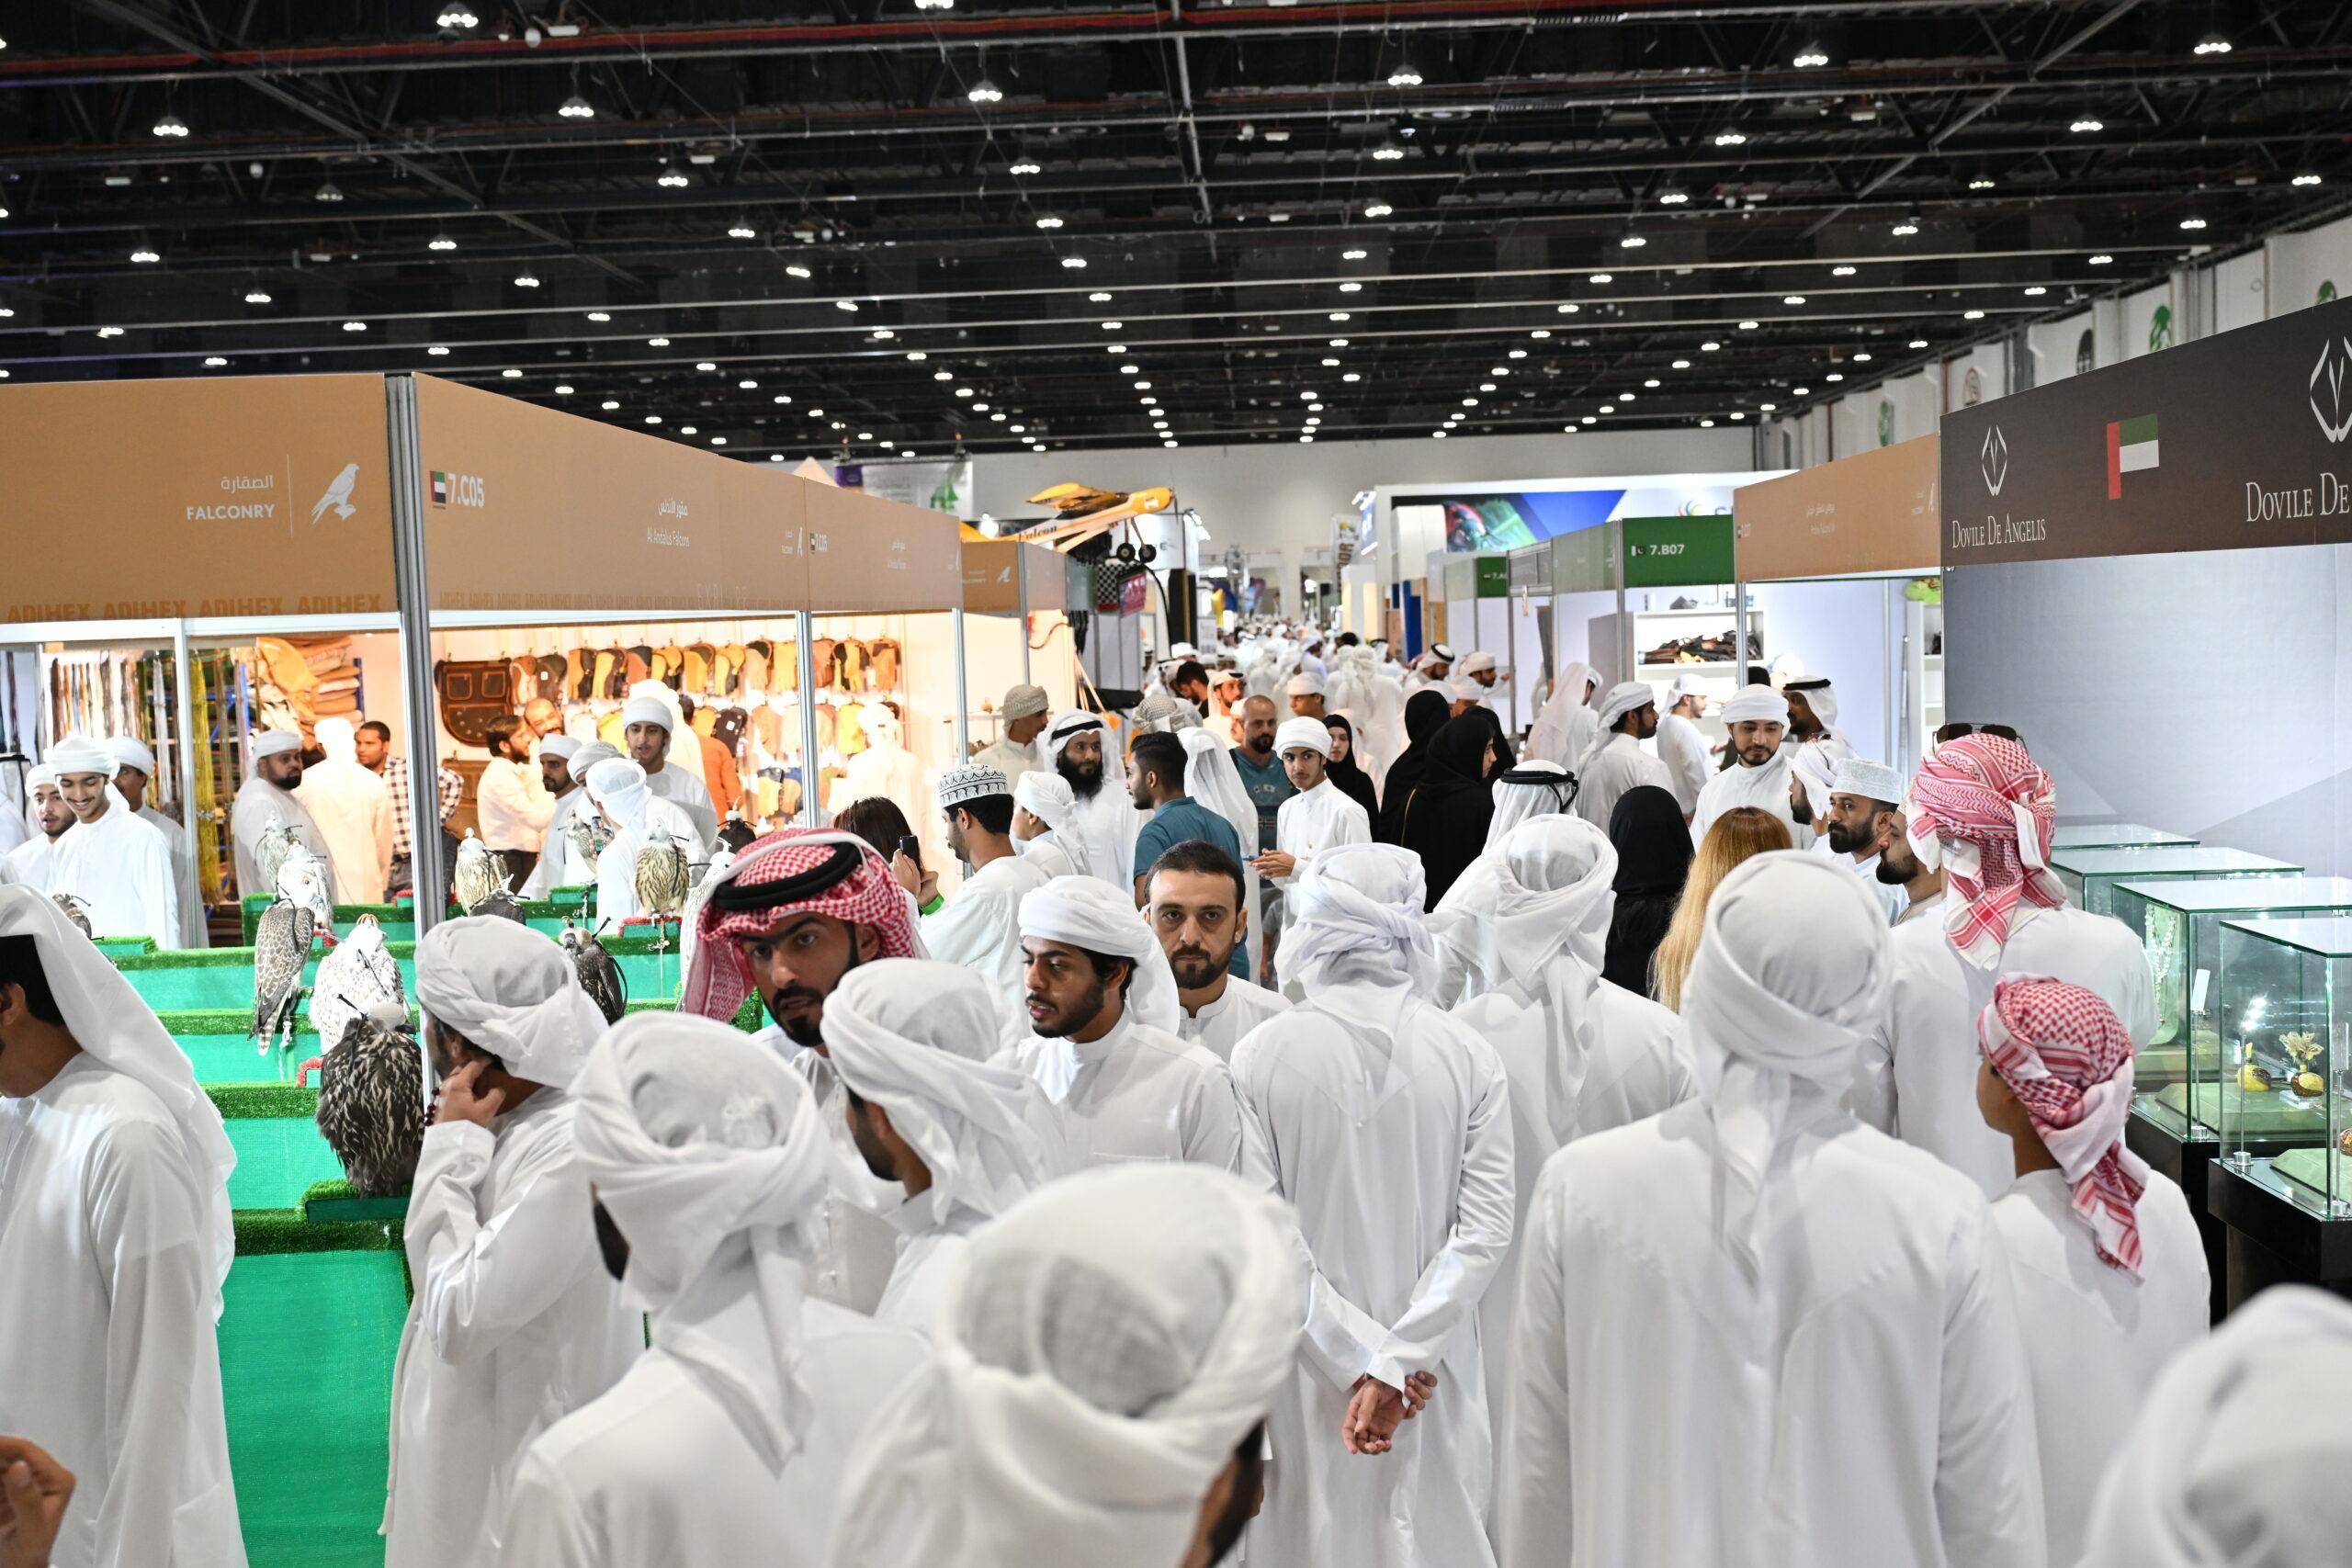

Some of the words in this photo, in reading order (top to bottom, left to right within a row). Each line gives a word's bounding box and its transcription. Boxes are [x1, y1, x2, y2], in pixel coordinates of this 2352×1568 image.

[220, 474, 274, 494] الصقارة
[447, 472, 485, 508] 7.C05
[187, 503, 275, 521] FALCONRY
[1649, 544, 1685, 556] 7.B07
[7, 603, 91, 623] ADIHEX
[103, 600, 187, 620] ADIHEX
[199, 597, 284, 617] ADIHEX
[297, 594, 381, 615] ADIHEX
